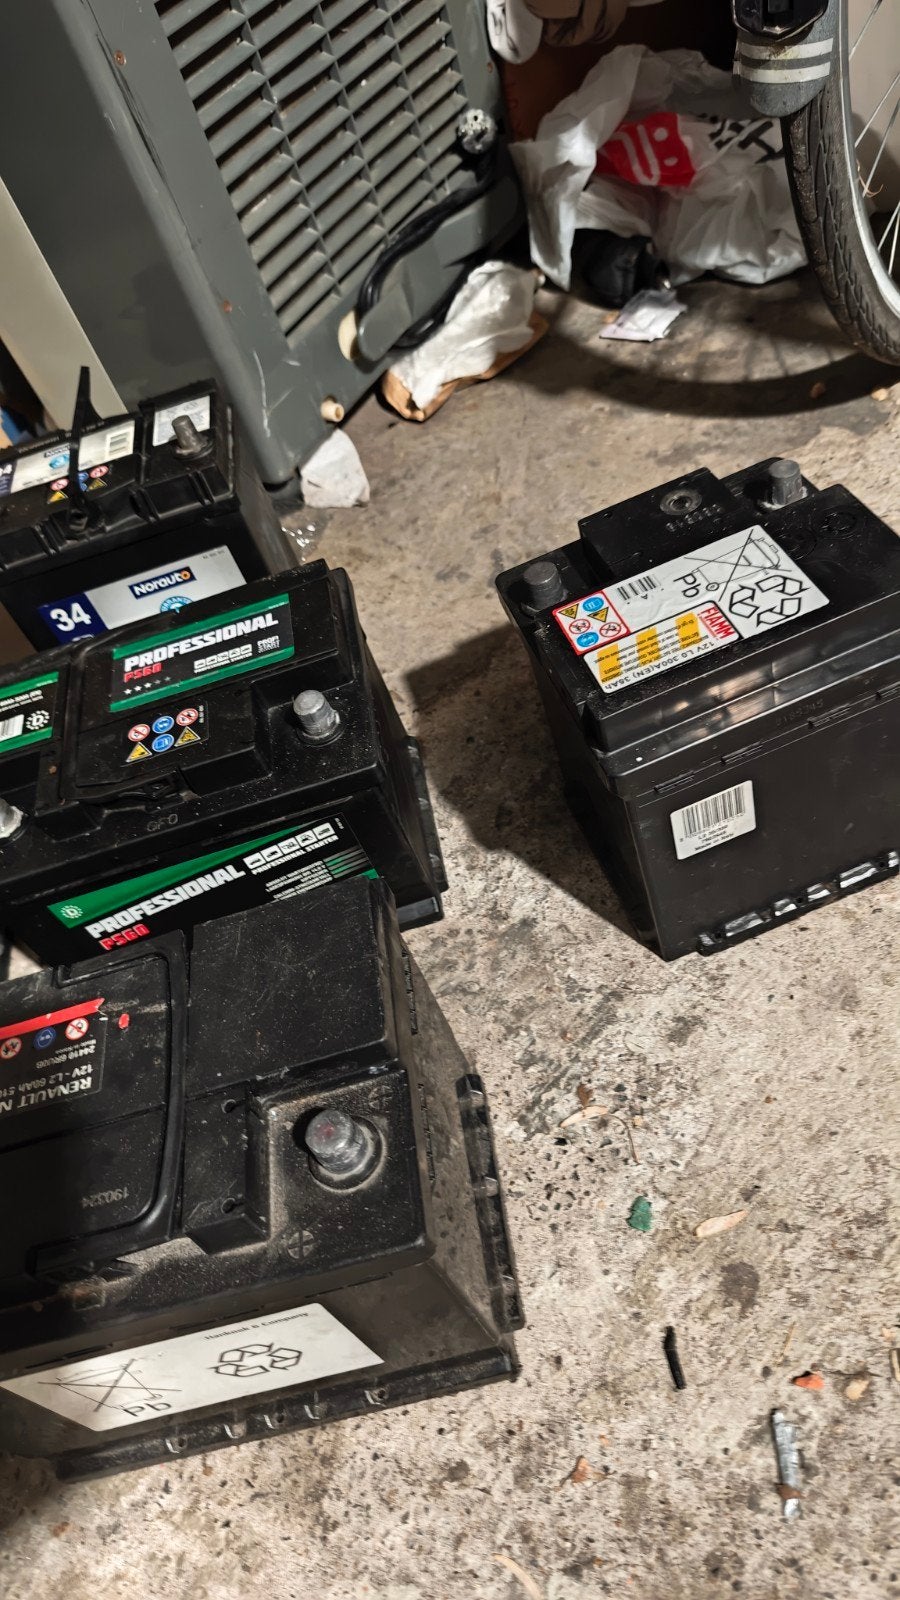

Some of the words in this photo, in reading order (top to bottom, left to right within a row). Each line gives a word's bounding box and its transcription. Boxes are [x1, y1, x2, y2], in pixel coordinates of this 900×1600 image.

[132, 570, 191, 597] Norauto
[673, 572, 700, 598] Pb
[51, 602, 92, 632] 34
[700, 602, 735, 640] FIAMM
[124, 612, 279, 673] PROFESSIONAL
[696, 640, 714, 652] 12V
[85, 864, 246, 939] PROFESSIONAL
[71, 1064, 93, 1077] 12V
[16, 1076, 92, 1109] RENAULT
[123, 1401, 172, 1417] Pb
